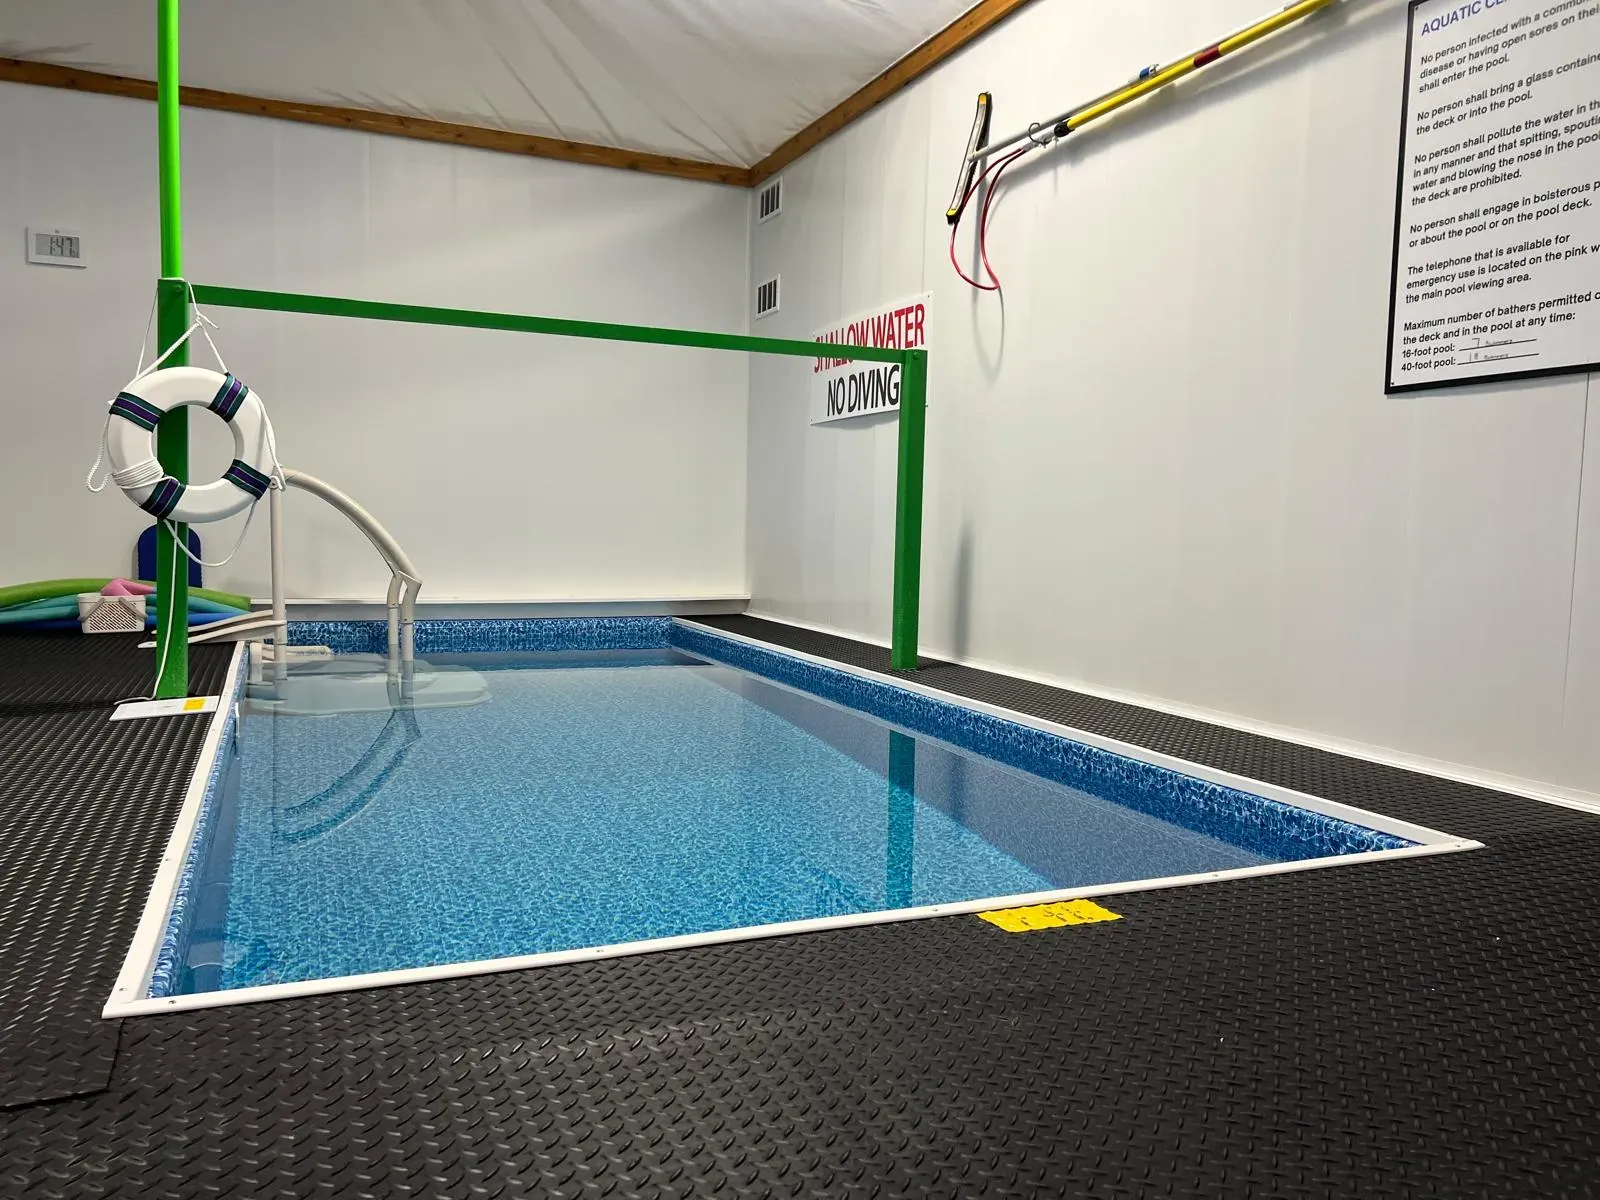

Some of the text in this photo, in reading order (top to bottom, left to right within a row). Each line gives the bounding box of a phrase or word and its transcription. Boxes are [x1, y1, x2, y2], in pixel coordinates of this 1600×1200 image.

[1420, 54, 1433, 65] No
[1435, 42, 1467, 61] person
[1469, 24, 1508, 46] infected
[1510, 15, 1531, 30] with
[1534, 13, 1540, 21] a
[1421, 1, 1481, 36] AQUATIC
[1420, 61, 1454, 79] disease
[1456, 55, 1467, 66] or
[1469, 44, 1499, 61] having
[1501, 34, 1526, 49] open
[1529, 21, 1558, 38] sores
[1561, 16, 1575, 26] on
[1417, 110, 1430, 121] No
[1431, 99, 1463, 118] person
[1465, 89, 1488, 105] shall
[1490, 81, 1515, 97] bring
[1517, 79, 1524, 88] a
[1526, 69, 1554, 87] glass
[1419, 53, 1510, 93] shall enter the pool.
[1414, 154, 1427, 165] No
[1429, 143, 1461, 162] person
[1463, 134, 1485, 149] shall
[1487, 124, 1522, 144] pollute
[1525, 116, 1541, 129] the
[1544, 108, 1574, 124] water
[1577, 104, 1586, 115] in
[1416, 90, 1533, 136] the deck or into the pool.
[1412, 178, 1438, 192] water
[1439, 171, 1457, 185] and
[1458, 160, 1497, 179] blowing
[1498, 154, 1515, 167] the
[1516, 147, 1543, 163] nose
[1545, 143, 1554, 155] in
[1557, 138, 1574, 152] the
[1413, 168, 1421, 178] in
[1423, 164, 1439, 178] any
[1441, 153, 1476, 171] manner
[1477, 145, 1496, 159] and
[1498, 139, 1517, 152] that
[1519, 128, 1561, 149] spitting,
[1409, 224, 1423, 235] No
[1424, 215, 1456, 233] person
[1458, 207, 1481, 223] shall
[1482, 199, 1520, 218] engage
[1521, 196, 1531, 207] in
[1533, 182, 1591, 205] boisterous
[1412, 169, 1522, 206] the deck are prohibited.
[1408, 197, 1593, 248] or about the pool or on the pool deck.
[1406, 272, 1456, 290] emergency
[1458, 268, 1476, 280] use
[1477, 265, 1486, 276] is
[1488, 255, 1527, 273] located
[1528, 255, 1542, 265] on
[1544, 250, 1562, 262] the
[1564, 244, 1588, 261] pink
[1407, 233, 1571, 276] The telephone that is available for
[1403, 317, 1445, 331] Maximum
[1447, 309, 1482, 324] number
[1484, 307, 1495, 318] of
[1497, 299, 1536, 316] bathers
[1538, 291, 1592, 312] permitted
[1405, 272, 1532, 304] the main pool viewing area.
[814, 303, 925, 373] SHALLOW WATER
[1403, 311, 1576, 345] the deck and in the pool at any time:
[1401, 358, 1456, 371] 40-foot pool:
[1402, 344, 1455, 359] 16-foot pool:
[827, 364, 900, 417] NO DIVING
